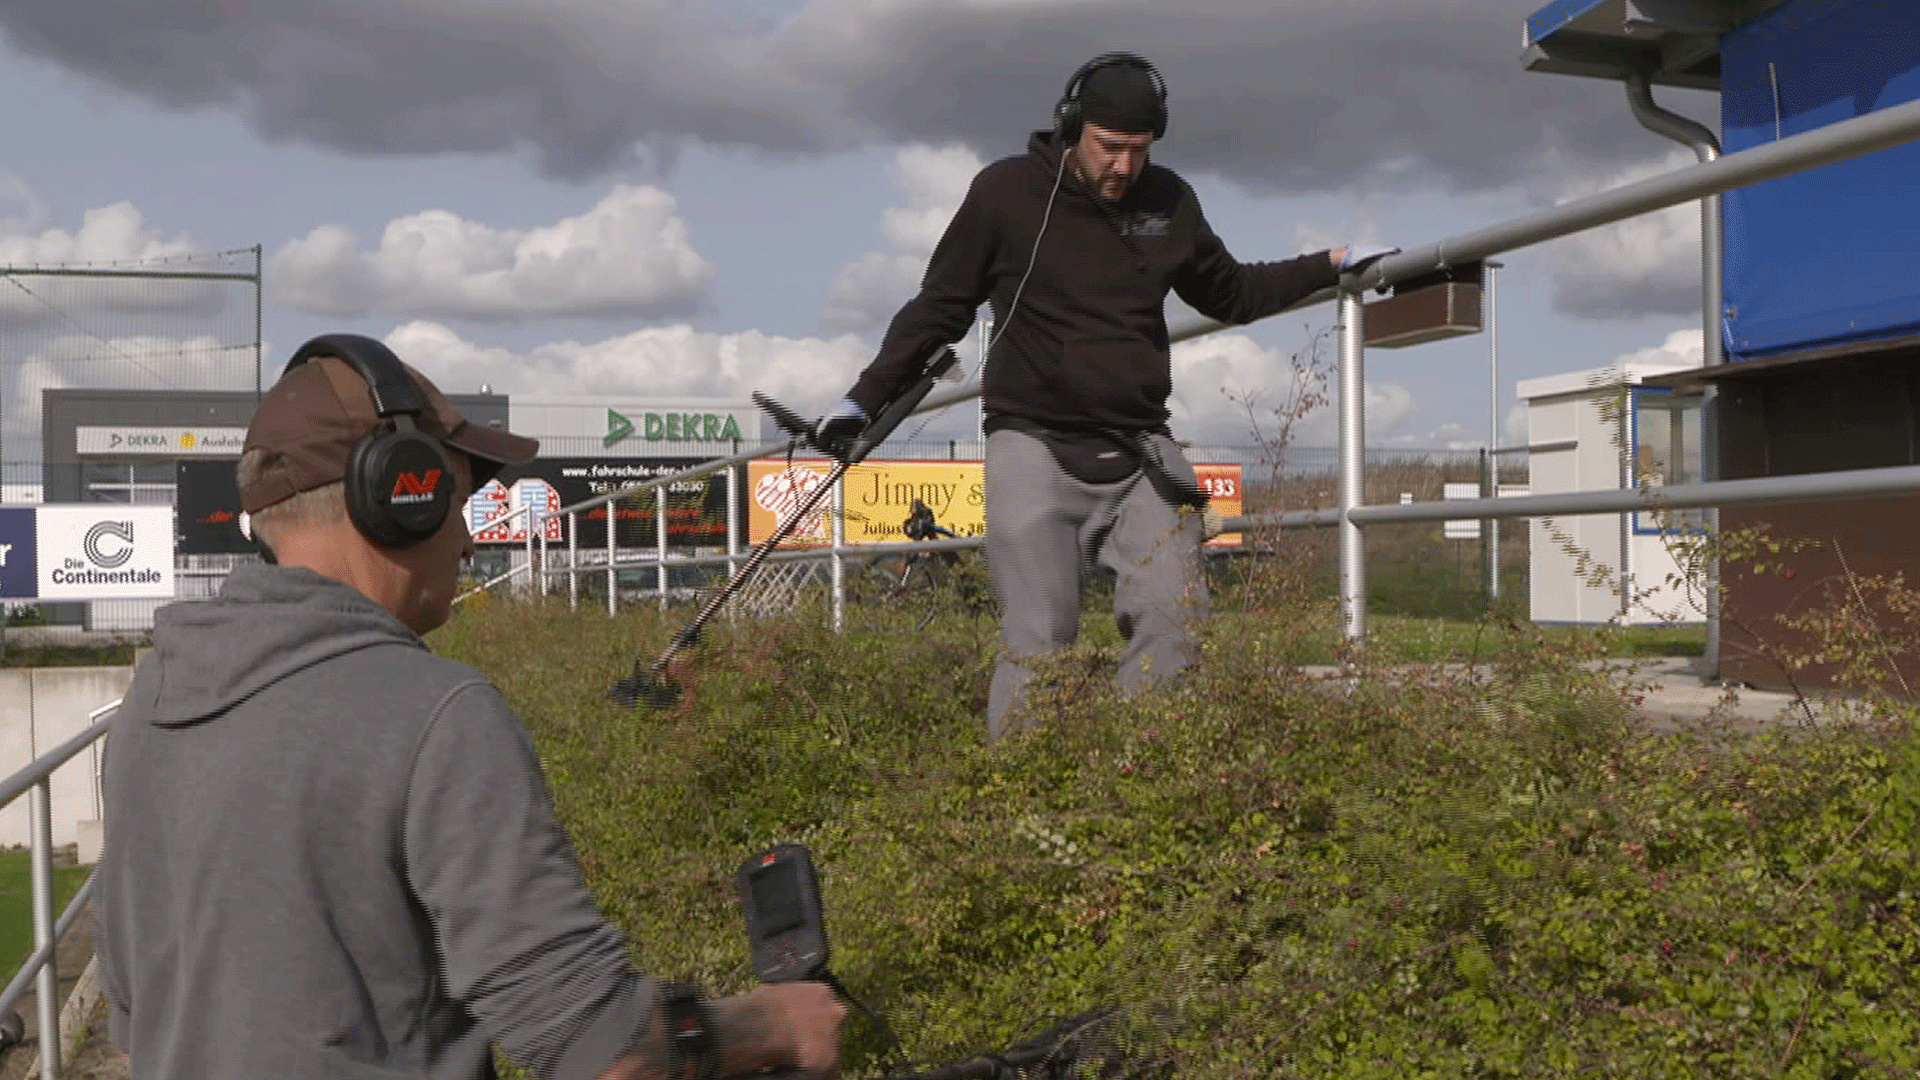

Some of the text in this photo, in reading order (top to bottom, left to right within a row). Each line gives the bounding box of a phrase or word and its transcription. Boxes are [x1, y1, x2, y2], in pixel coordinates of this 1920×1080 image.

[644, 412, 742, 440] DEKRA
[127, 434, 168, 446] DEKRA
[862, 473, 984, 519] Jimmy's
[863, 522, 904, 536] Julius
[64, 558, 85, 569] Die
[52, 568, 162, 584] Continentale
